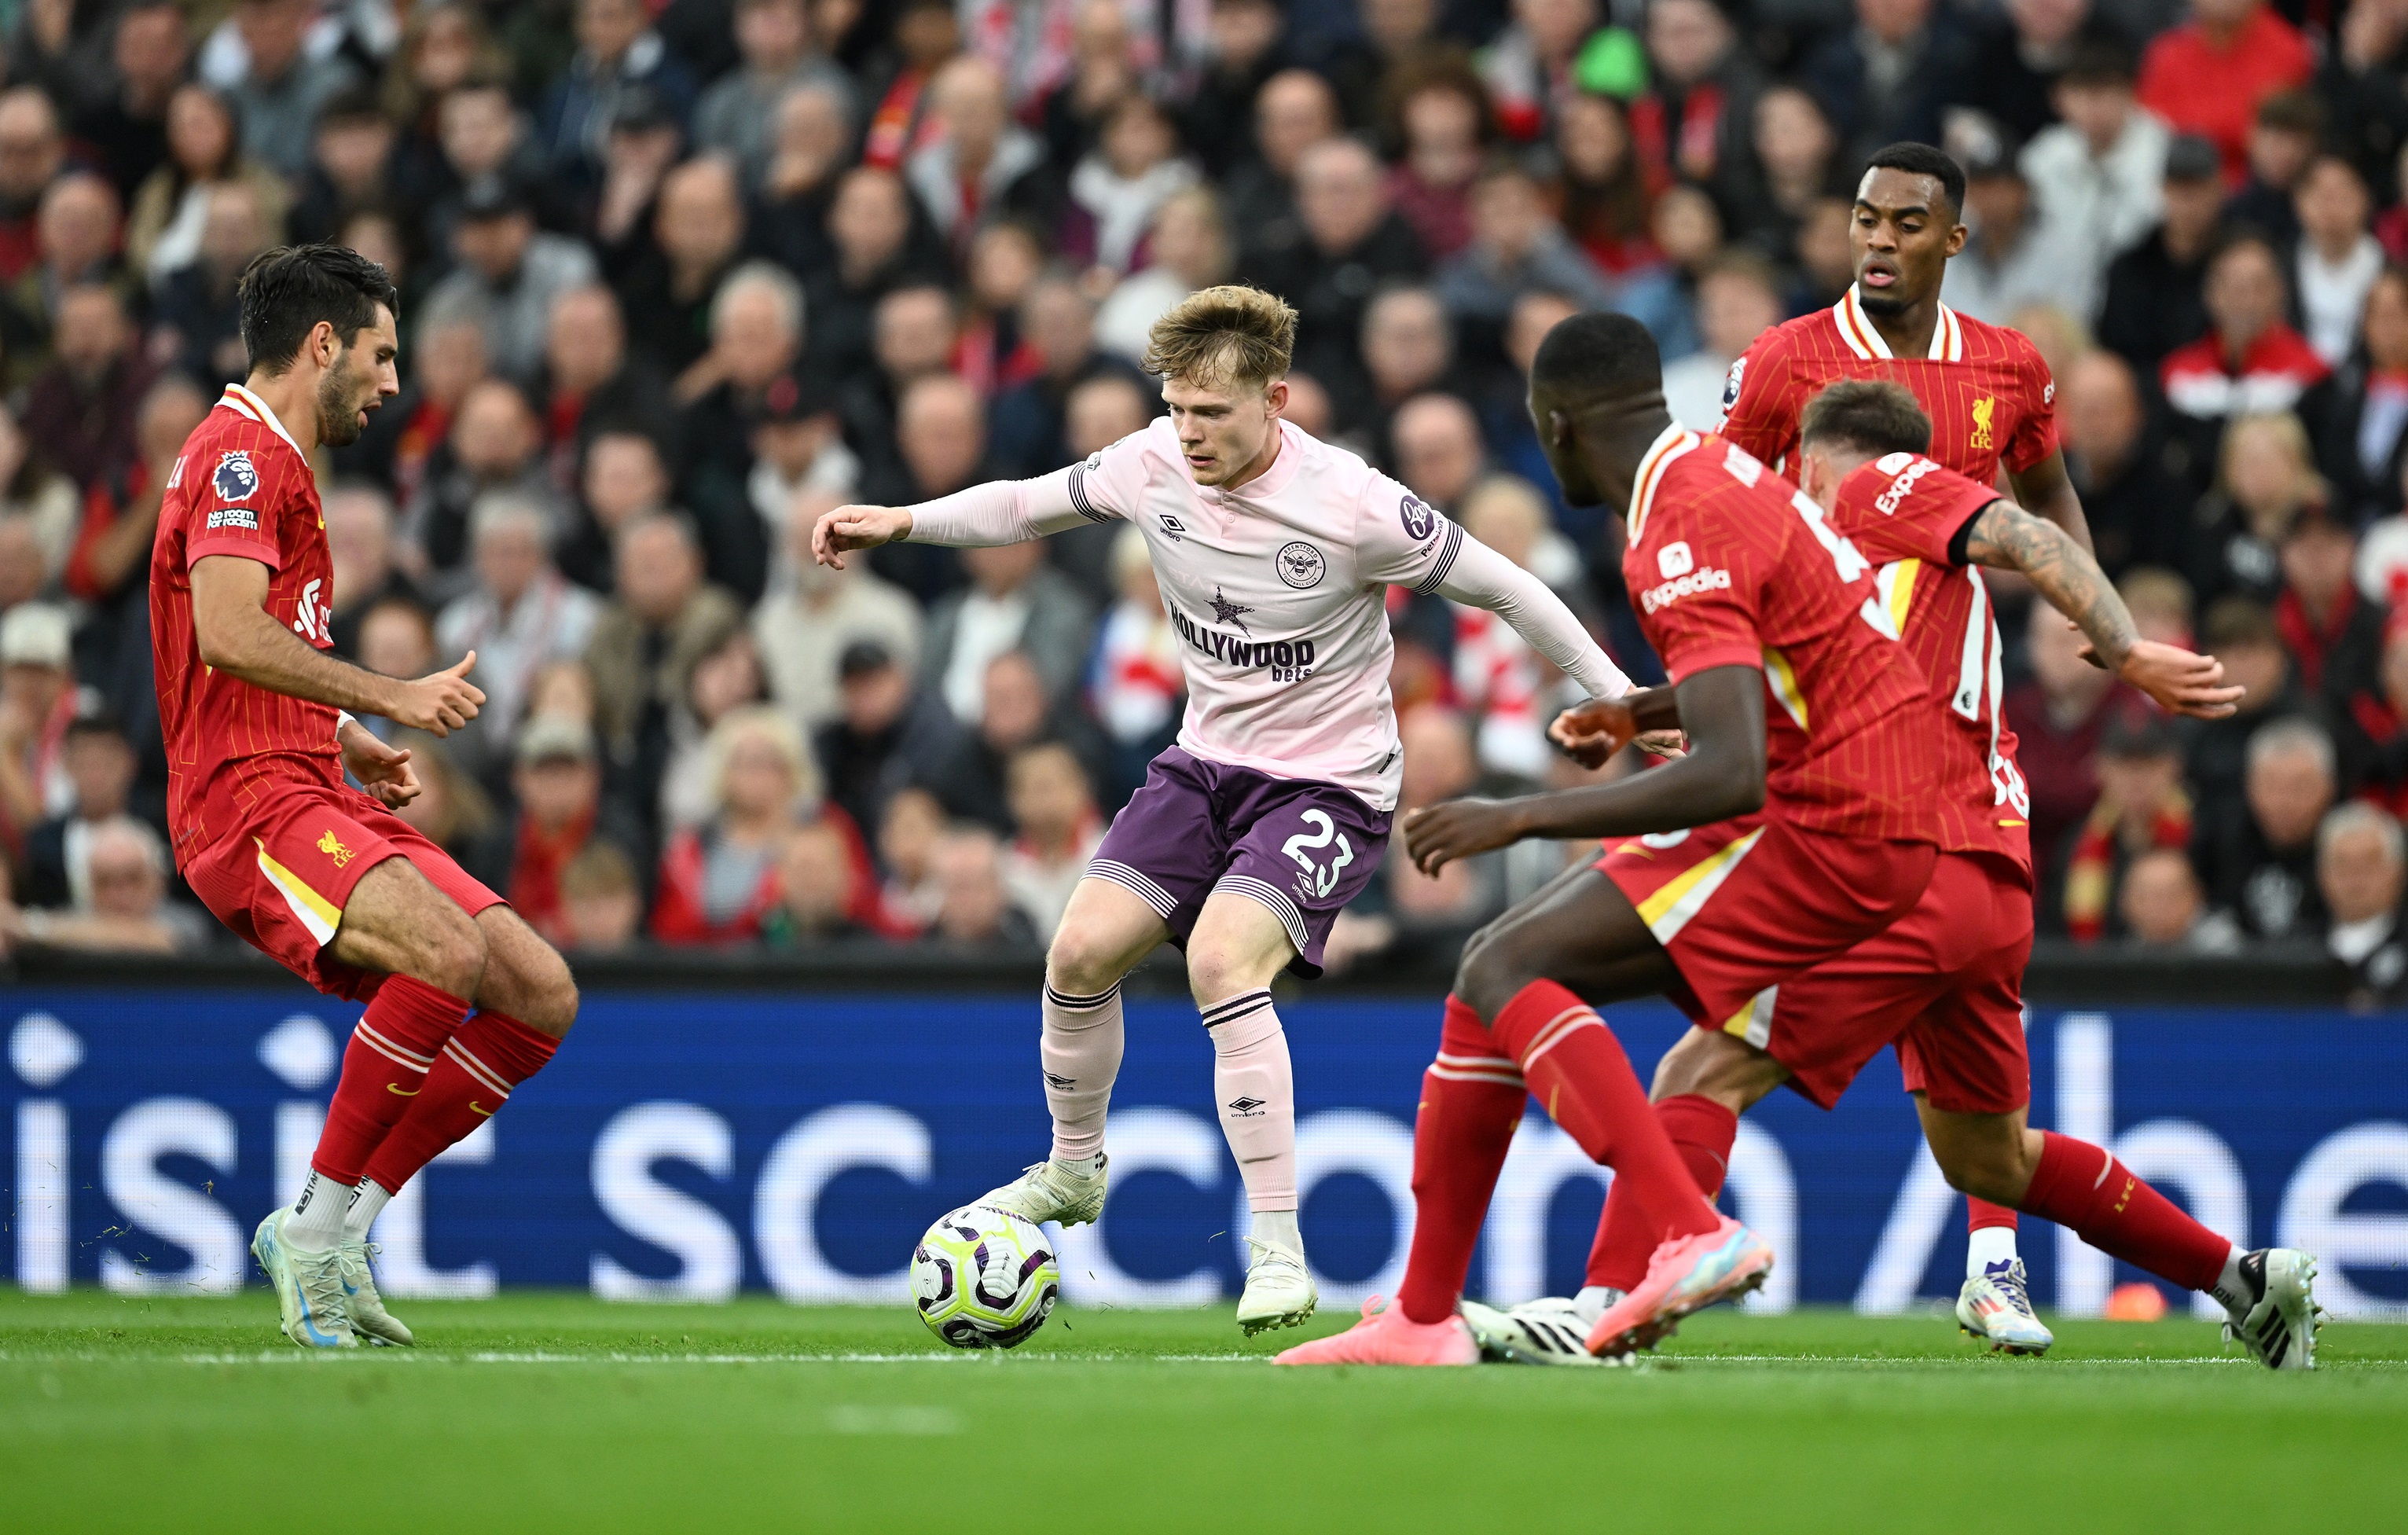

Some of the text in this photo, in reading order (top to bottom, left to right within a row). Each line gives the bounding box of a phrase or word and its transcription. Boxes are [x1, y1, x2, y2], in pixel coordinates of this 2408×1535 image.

[207, 509, 254, 520] No room
[222, 517, 258, 531] racism
[1159, 527, 1180, 542] umbro
[1283, 544, 1318, 558] BRENTFORD
[1283, 573, 1318, 586] FOOTBALL CLUB
[1169, 600, 1315, 667] HOLLYWOOD
[1272, 665, 1312, 682] bets
[1280, 809, 1354, 898] 23
[1291, 883, 1307, 904] umbro
